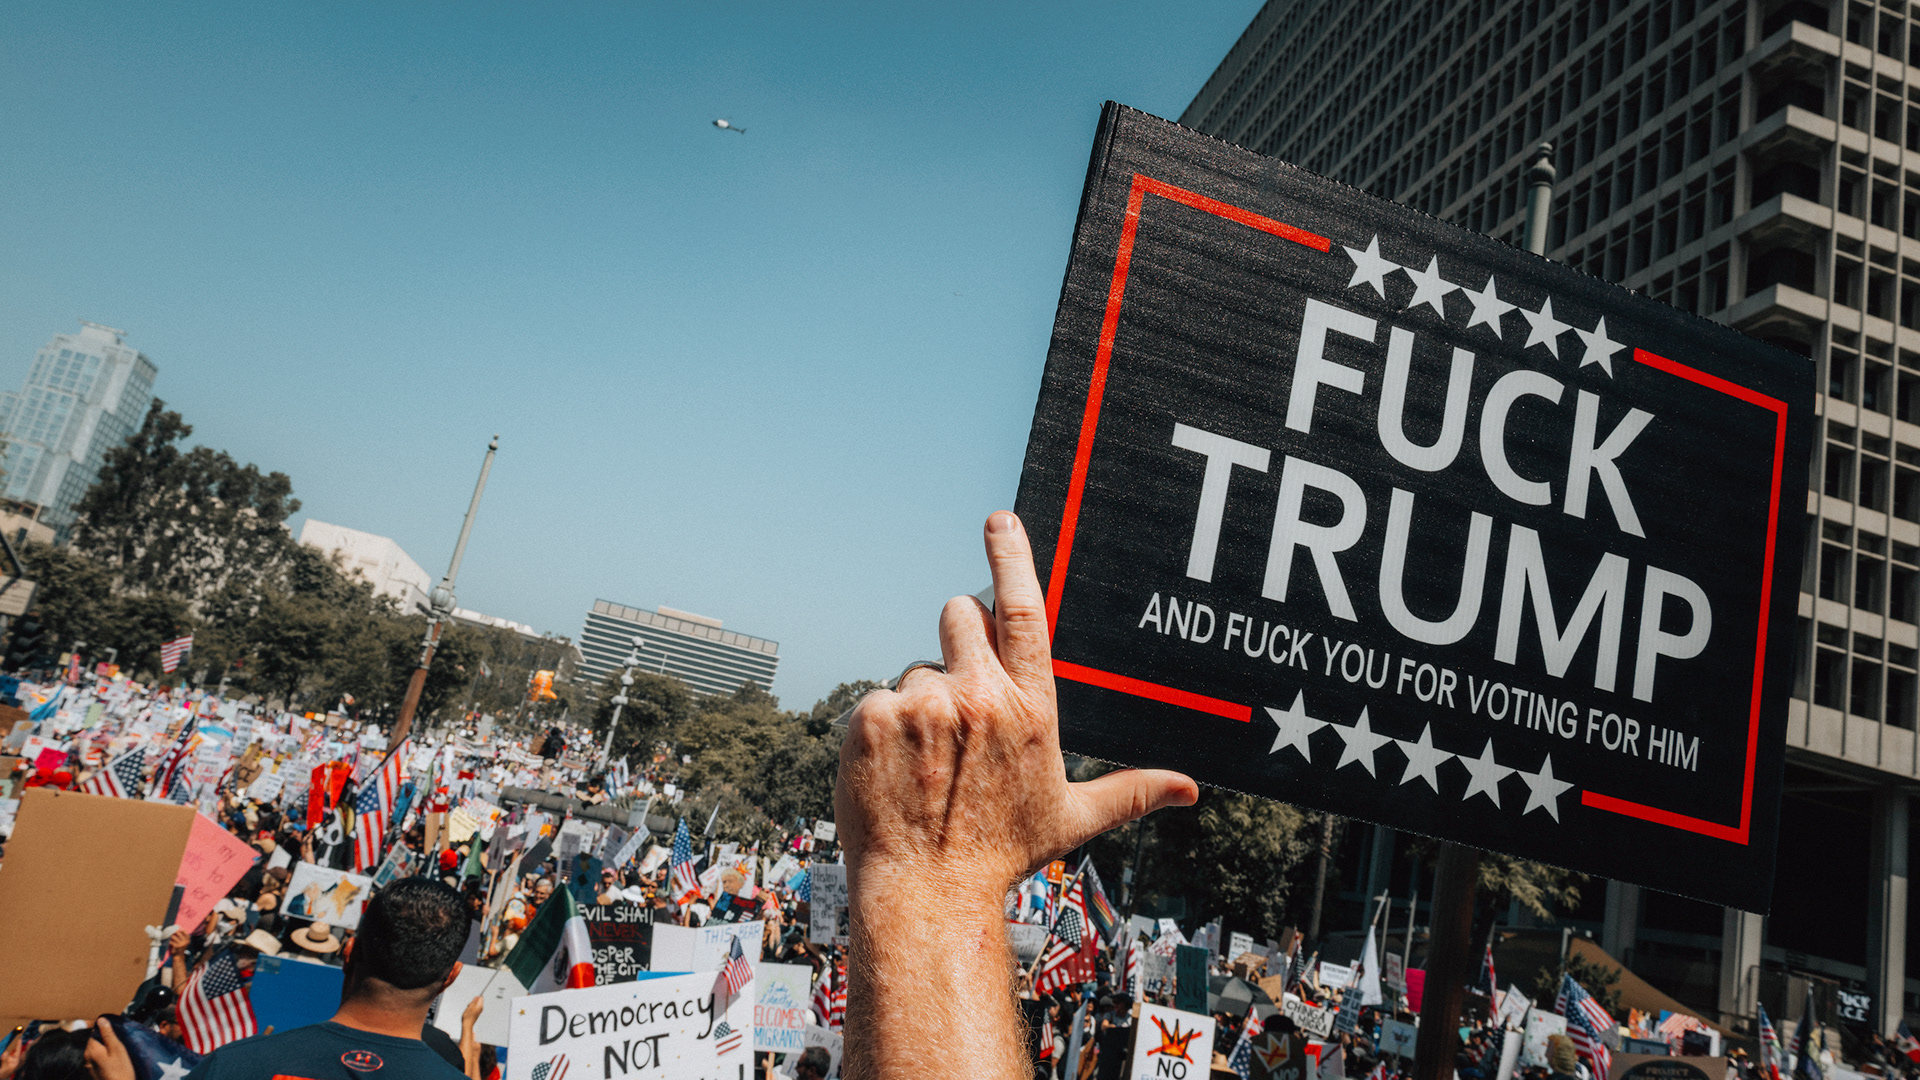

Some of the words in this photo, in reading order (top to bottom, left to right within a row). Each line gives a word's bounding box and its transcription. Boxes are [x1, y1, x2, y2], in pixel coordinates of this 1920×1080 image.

[1284, 297, 1656, 539] FUCK
[1170, 421, 1712, 704] TRUMP
[1137, 591, 1216, 644] AND
[1223, 611, 1314, 671] FUCK
[1322, 636, 1391, 689] YOU
[1396, 657, 1458, 709] FOR
[1467, 674, 1579, 739] VOTING
[1585, 707, 1641, 757] FOR
[1647, 724, 1700, 772] HIM
[576, 903, 612, 922] EVIL
[589, 921, 643, 938] NEVER
[704, 927, 732, 944] THIS
[739, 924, 762, 940] BEAR
[592, 945, 636, 964] OSPeR
[593, 962, 618, 975] THE
[618, 962, 650, 976] CITY
[595, 974, 615, 985] OF
[539, 993, 716, 1046] Democracy
[754, 1004, 806, 1030] ELCOMES
[1286, 1000, 1326, 1023] CHINGA
[1298, 1013, 1328, 1034] MIGRA
[753, 1027, 806, 1049] MIGRANTS
[603, 1033, 670, 1080] NOT
[1156, 1057, 1187, 1080] NO
